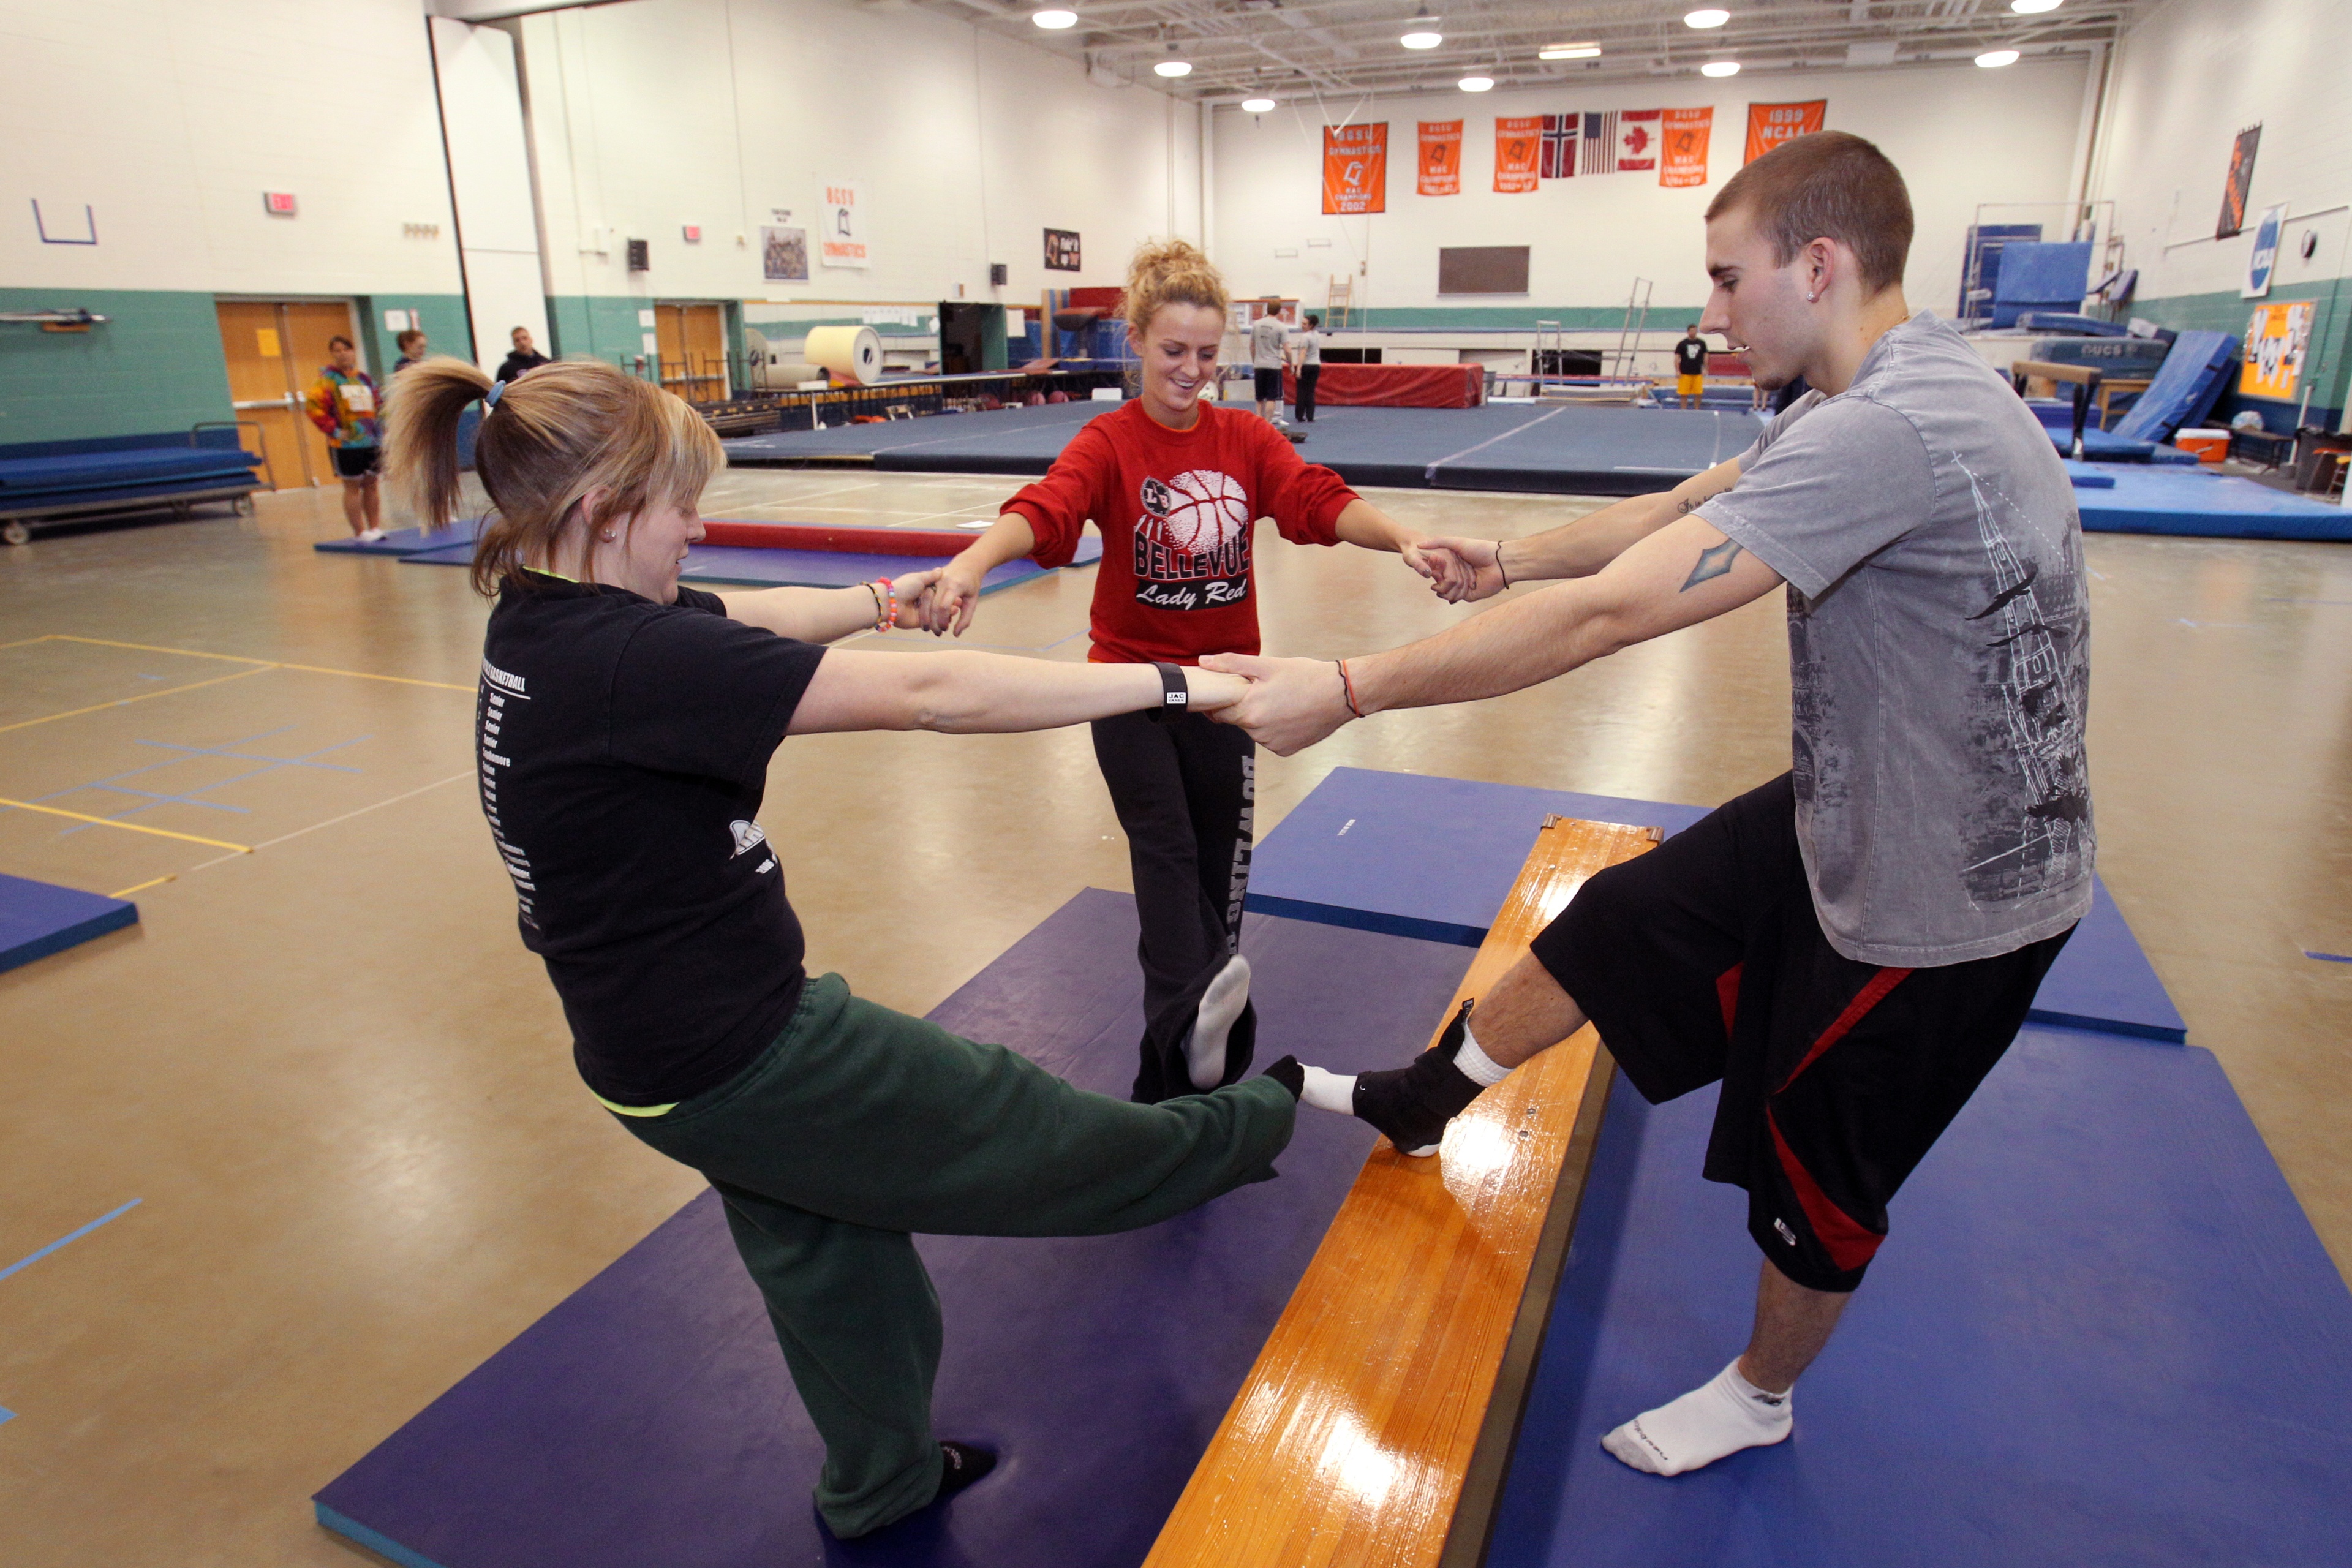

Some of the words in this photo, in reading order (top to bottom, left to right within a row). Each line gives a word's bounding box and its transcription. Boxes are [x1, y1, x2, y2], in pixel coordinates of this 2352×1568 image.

[1762, 125, 1805, 138] NCAA
[1134, 521, 1250, 581] BELLEVUE
[1136, 584, 1197, 610] Lady
[1205, 579, 1247, 605] Red
[489, 665, 526, 692] BASKETBALL
